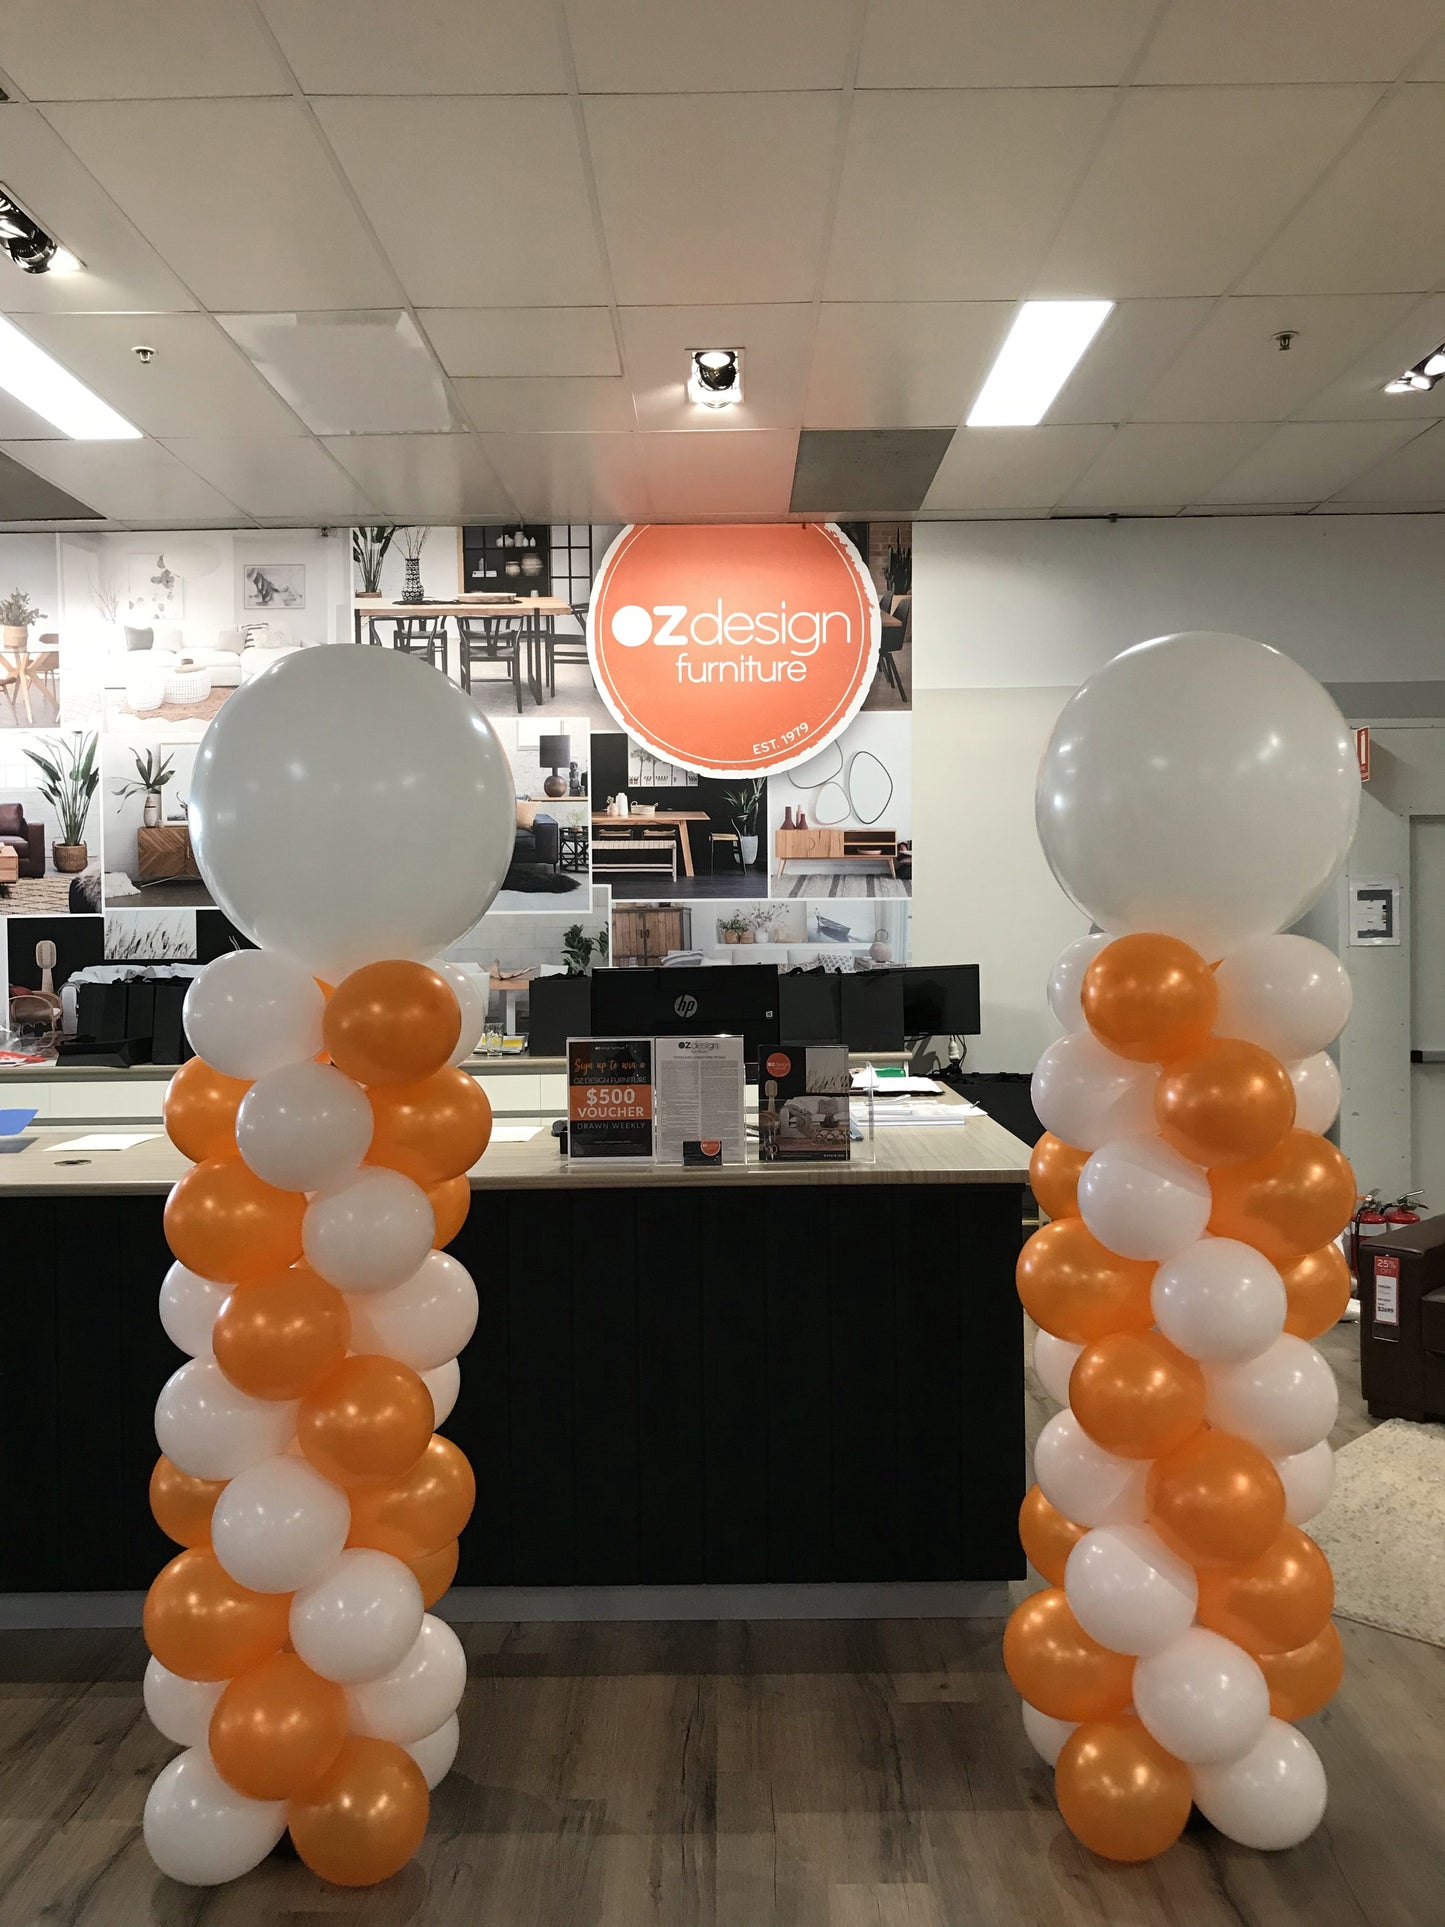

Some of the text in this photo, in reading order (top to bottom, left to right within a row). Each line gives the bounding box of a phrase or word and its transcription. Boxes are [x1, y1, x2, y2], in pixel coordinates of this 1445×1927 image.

[675, 652, 807, 683] furniture
[752, 722, 809, 755] EST. 1979
[676, 994, 697, 1018] hp
[574, 1057, 593, 1076] Sign
[596, 1061, 607, 1074] up
[609, 1058, 618, 1071] to
[621, 1061, 637, 1070] win
[611, 1076, 648, 1084] FURNITURE
[586, 1087, 636, 1107] $500
[577, 1106, 645, 1118] VOUCHER
[577, 1121, 646, 1130] DRAWN WEEKLY
[1377, 1259, 1396, 1269] 25%
